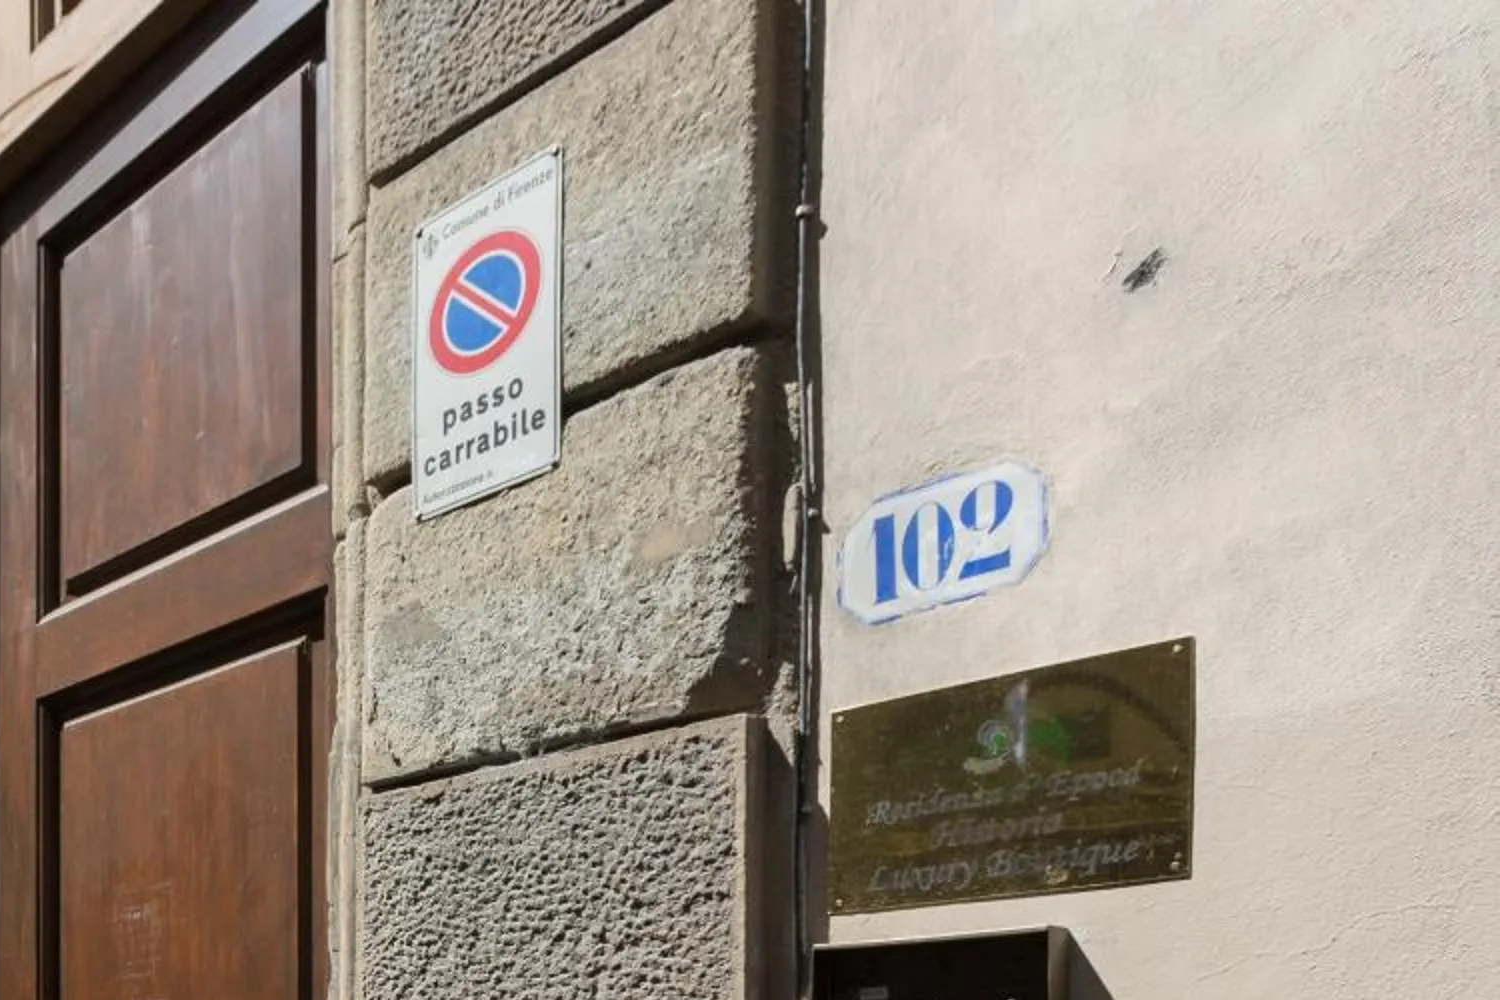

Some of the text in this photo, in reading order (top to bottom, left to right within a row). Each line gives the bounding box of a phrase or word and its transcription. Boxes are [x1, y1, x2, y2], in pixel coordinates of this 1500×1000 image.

[493, 190, 506, 211] di
[443, 377, 524, 436] passo
[424, 408, 546, 477] carrabile
[873, 479, 1014, 605] 102
